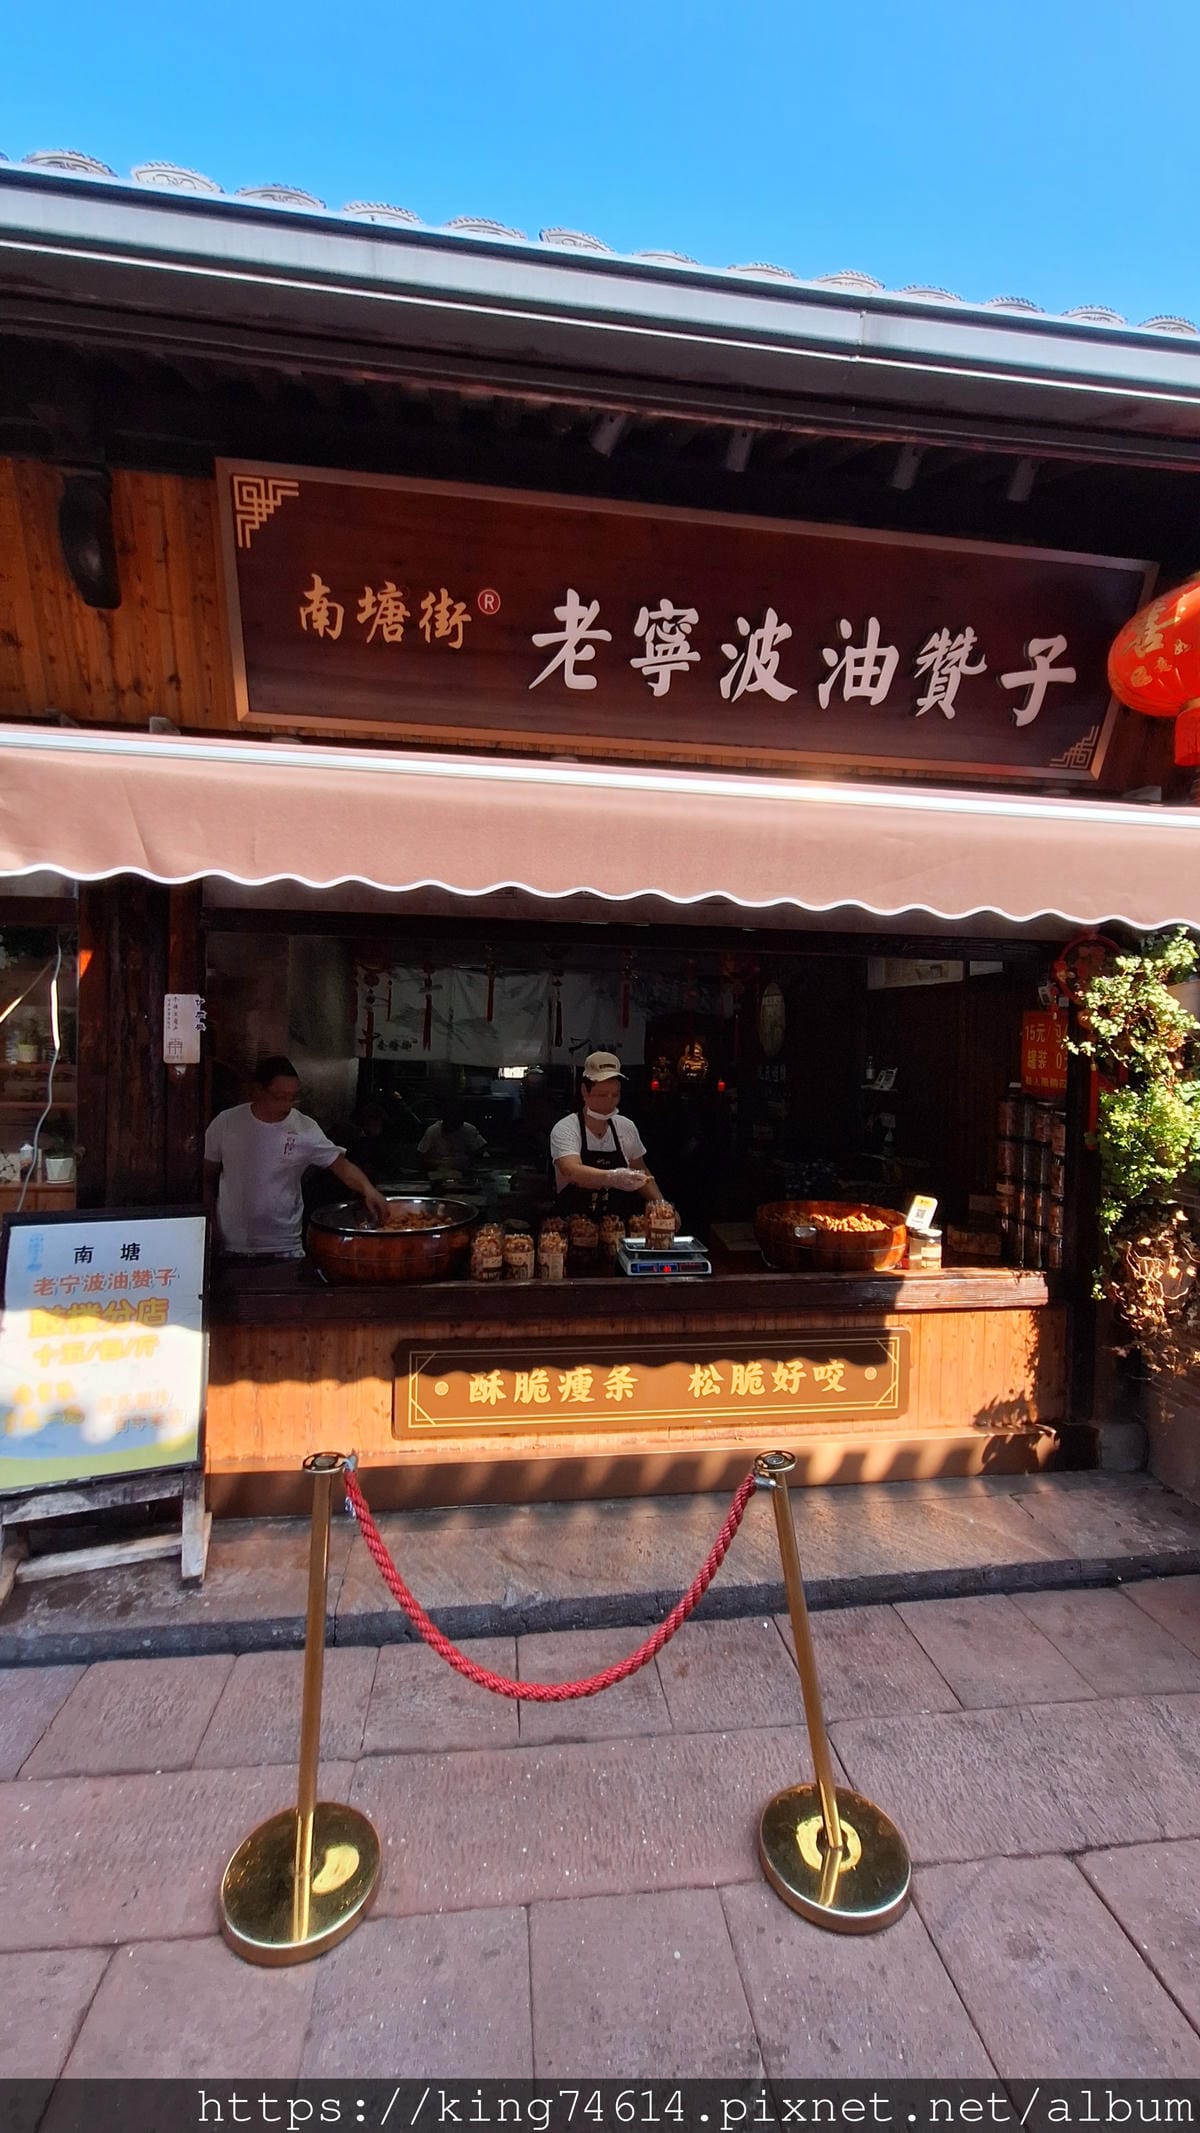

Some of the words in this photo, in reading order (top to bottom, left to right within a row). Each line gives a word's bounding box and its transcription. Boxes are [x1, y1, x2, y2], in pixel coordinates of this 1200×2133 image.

[299, 573, 472, 649] 南塘街
[34, 1268, 176, 1296] 老宁波油赞子
[468, 1365, 639, 1405] 酥脆瘦条
[687, 1359, 847, 1398] 松脆好咬
